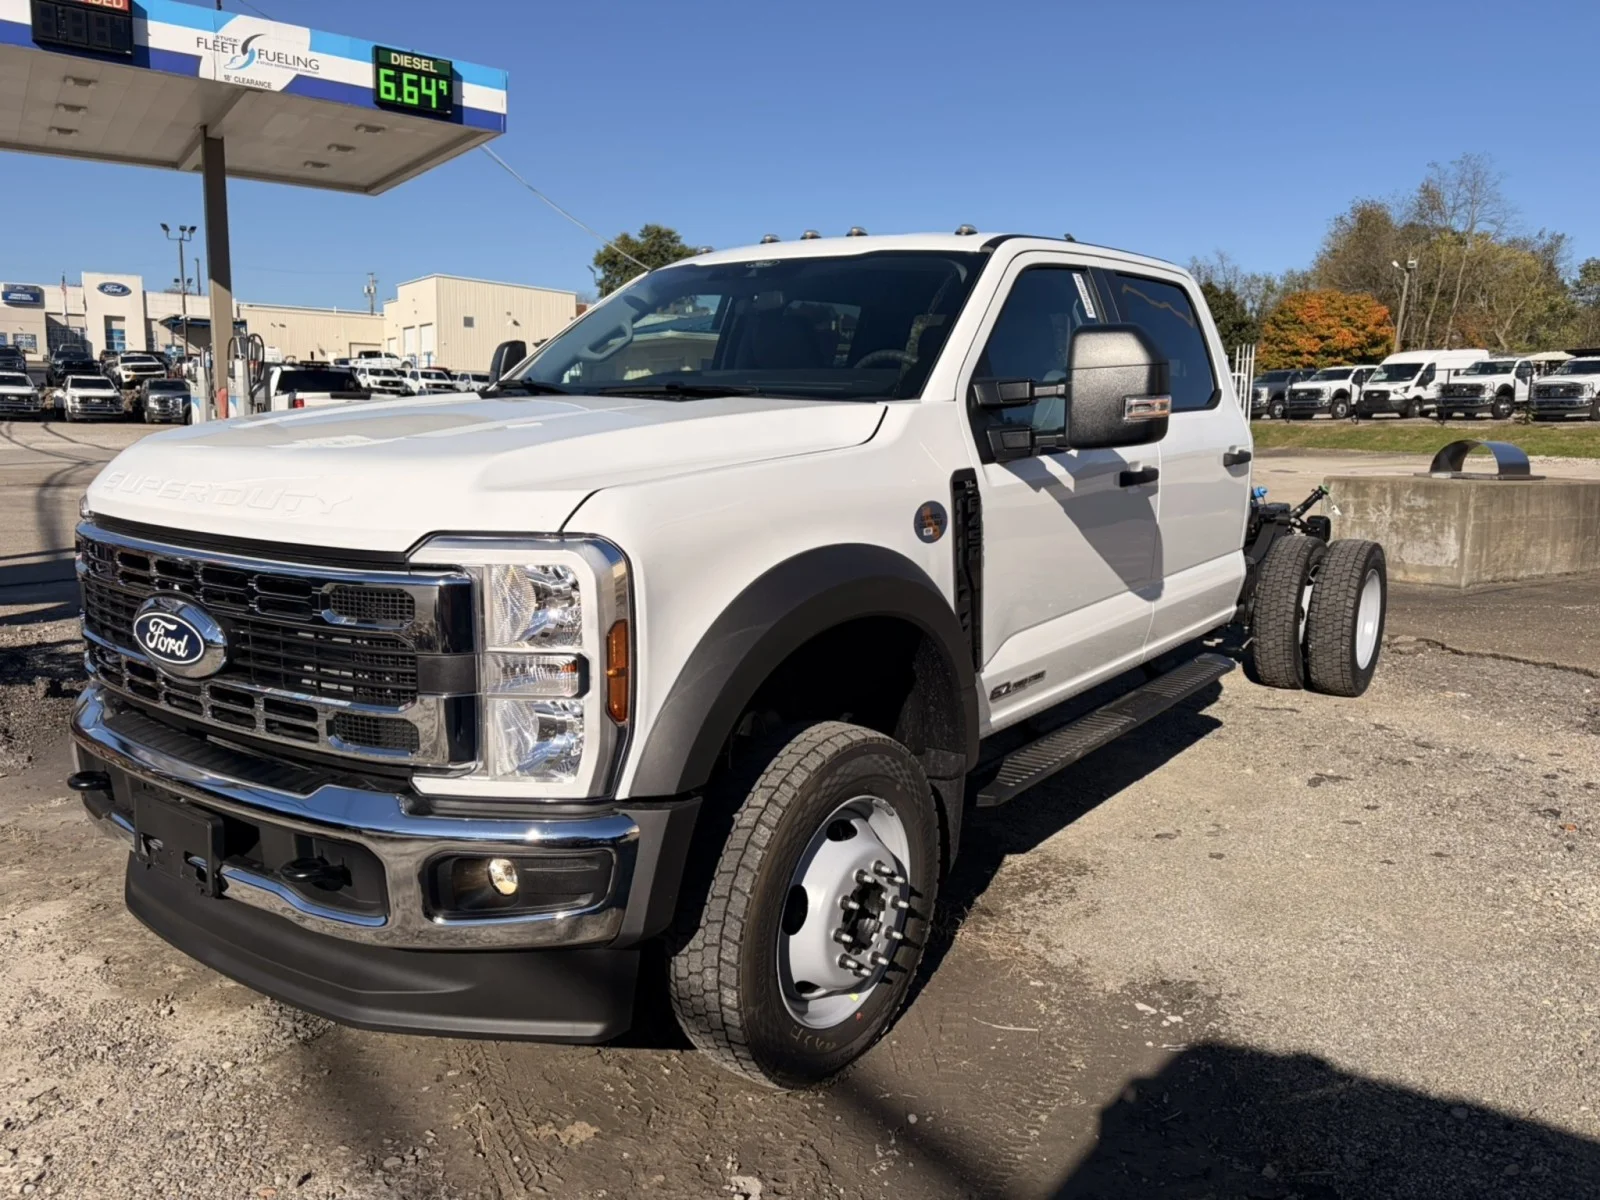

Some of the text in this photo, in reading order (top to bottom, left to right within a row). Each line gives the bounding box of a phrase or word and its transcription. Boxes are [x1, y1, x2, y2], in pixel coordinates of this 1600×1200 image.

[196, 37, 320, 71] FLEET FUELING
[391, 52, 438, 73] DIESEL
[234, 76, 273, 89] CLEARANCE
[146, 618, 188, 658] Ford
